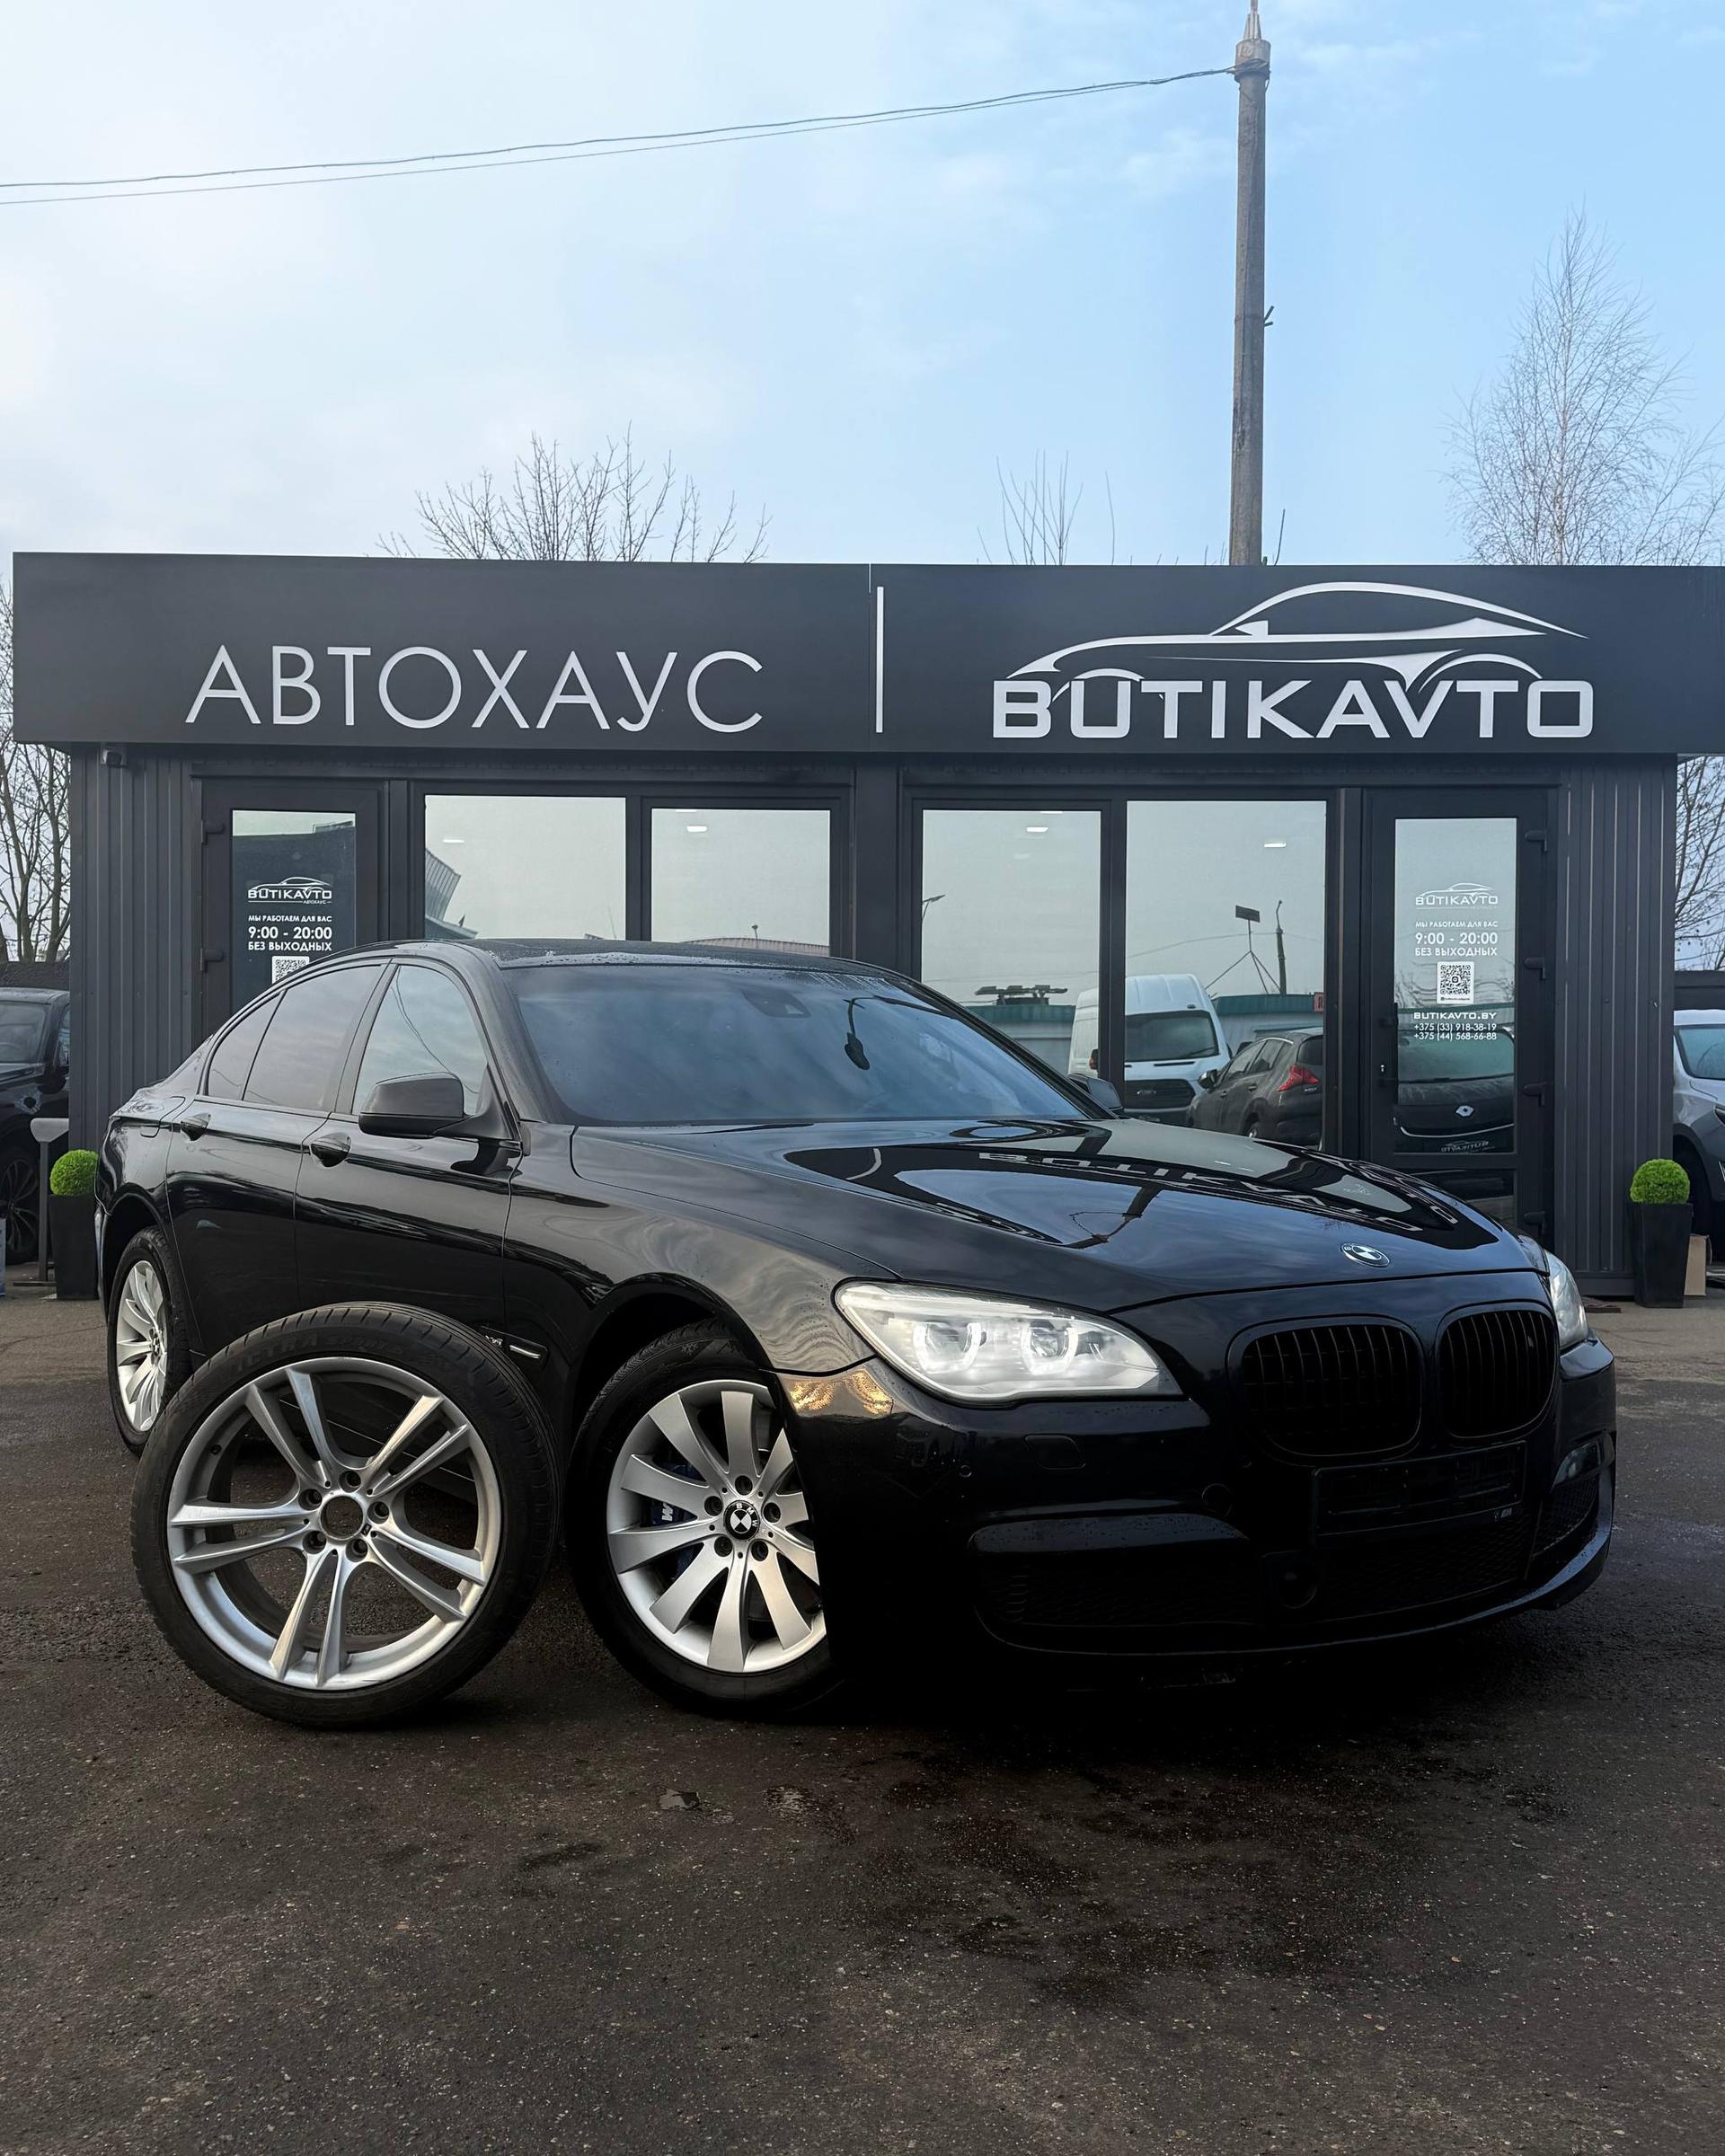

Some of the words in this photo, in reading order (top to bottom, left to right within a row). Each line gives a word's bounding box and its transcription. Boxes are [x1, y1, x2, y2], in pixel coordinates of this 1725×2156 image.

[184, 643, 764, 734] АВТОХАУС
[992, 679, 1594, 739] BUTIKAVTO
[247, 888, 332, 899] BUTIKAVTO
[1415, 896, 1499, 906] BUTIKAVTO
[262, 915, 300, 923] РАБОТАЕМ
[248, 926, 279, 939] 9:00
[293, 926, 332, 940] 20:00
[1415, 932, 1445, 945] 9:00
[1459, 932, 1499, 945] 20:00
[248, 941, 266, 950] БЕЗ
[268, 941, 332, 952] ВЫХОДНЫХ
[1415, 947, 1432, 957] БЕЗ
[1435, 947, 1498, 958] ВЫХОДНЫХ
[1413, 1012, 1497, 1020] BUTIKAVTO.BY
[1414, 1022, 1435, 1031] +375
[1437, 1022, 1453, 1033] (33)
[1455, 1022, 1497, 1031] 918-38-19
[1414, 1031, 1435, 1040] +375
[1437, 1031, 1453, 1042] (44)
[1455, 1031, 1497, 1040] 568-66-88
